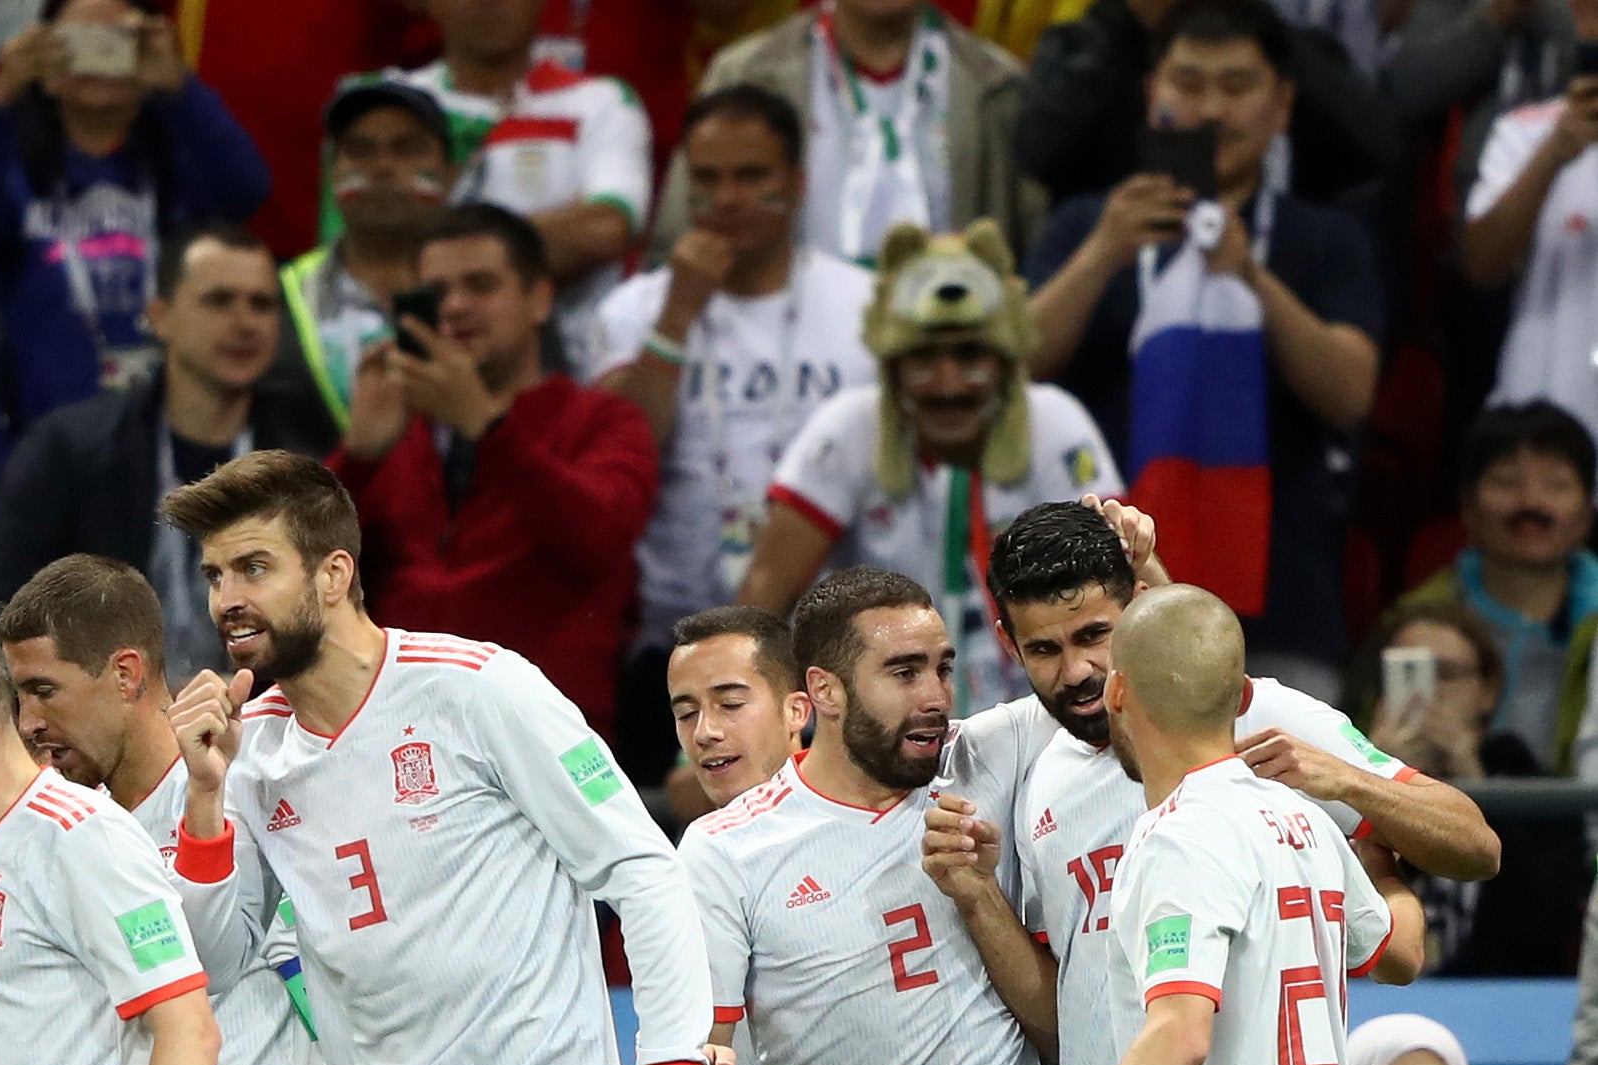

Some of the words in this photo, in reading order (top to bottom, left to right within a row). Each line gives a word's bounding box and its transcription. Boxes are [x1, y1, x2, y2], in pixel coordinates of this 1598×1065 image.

[267, 815, 302, 832] adidas
[334, 838, 388, 931] 3
[785, 890, 831, 909] adidas
[882, 902, 939, 993] 2
